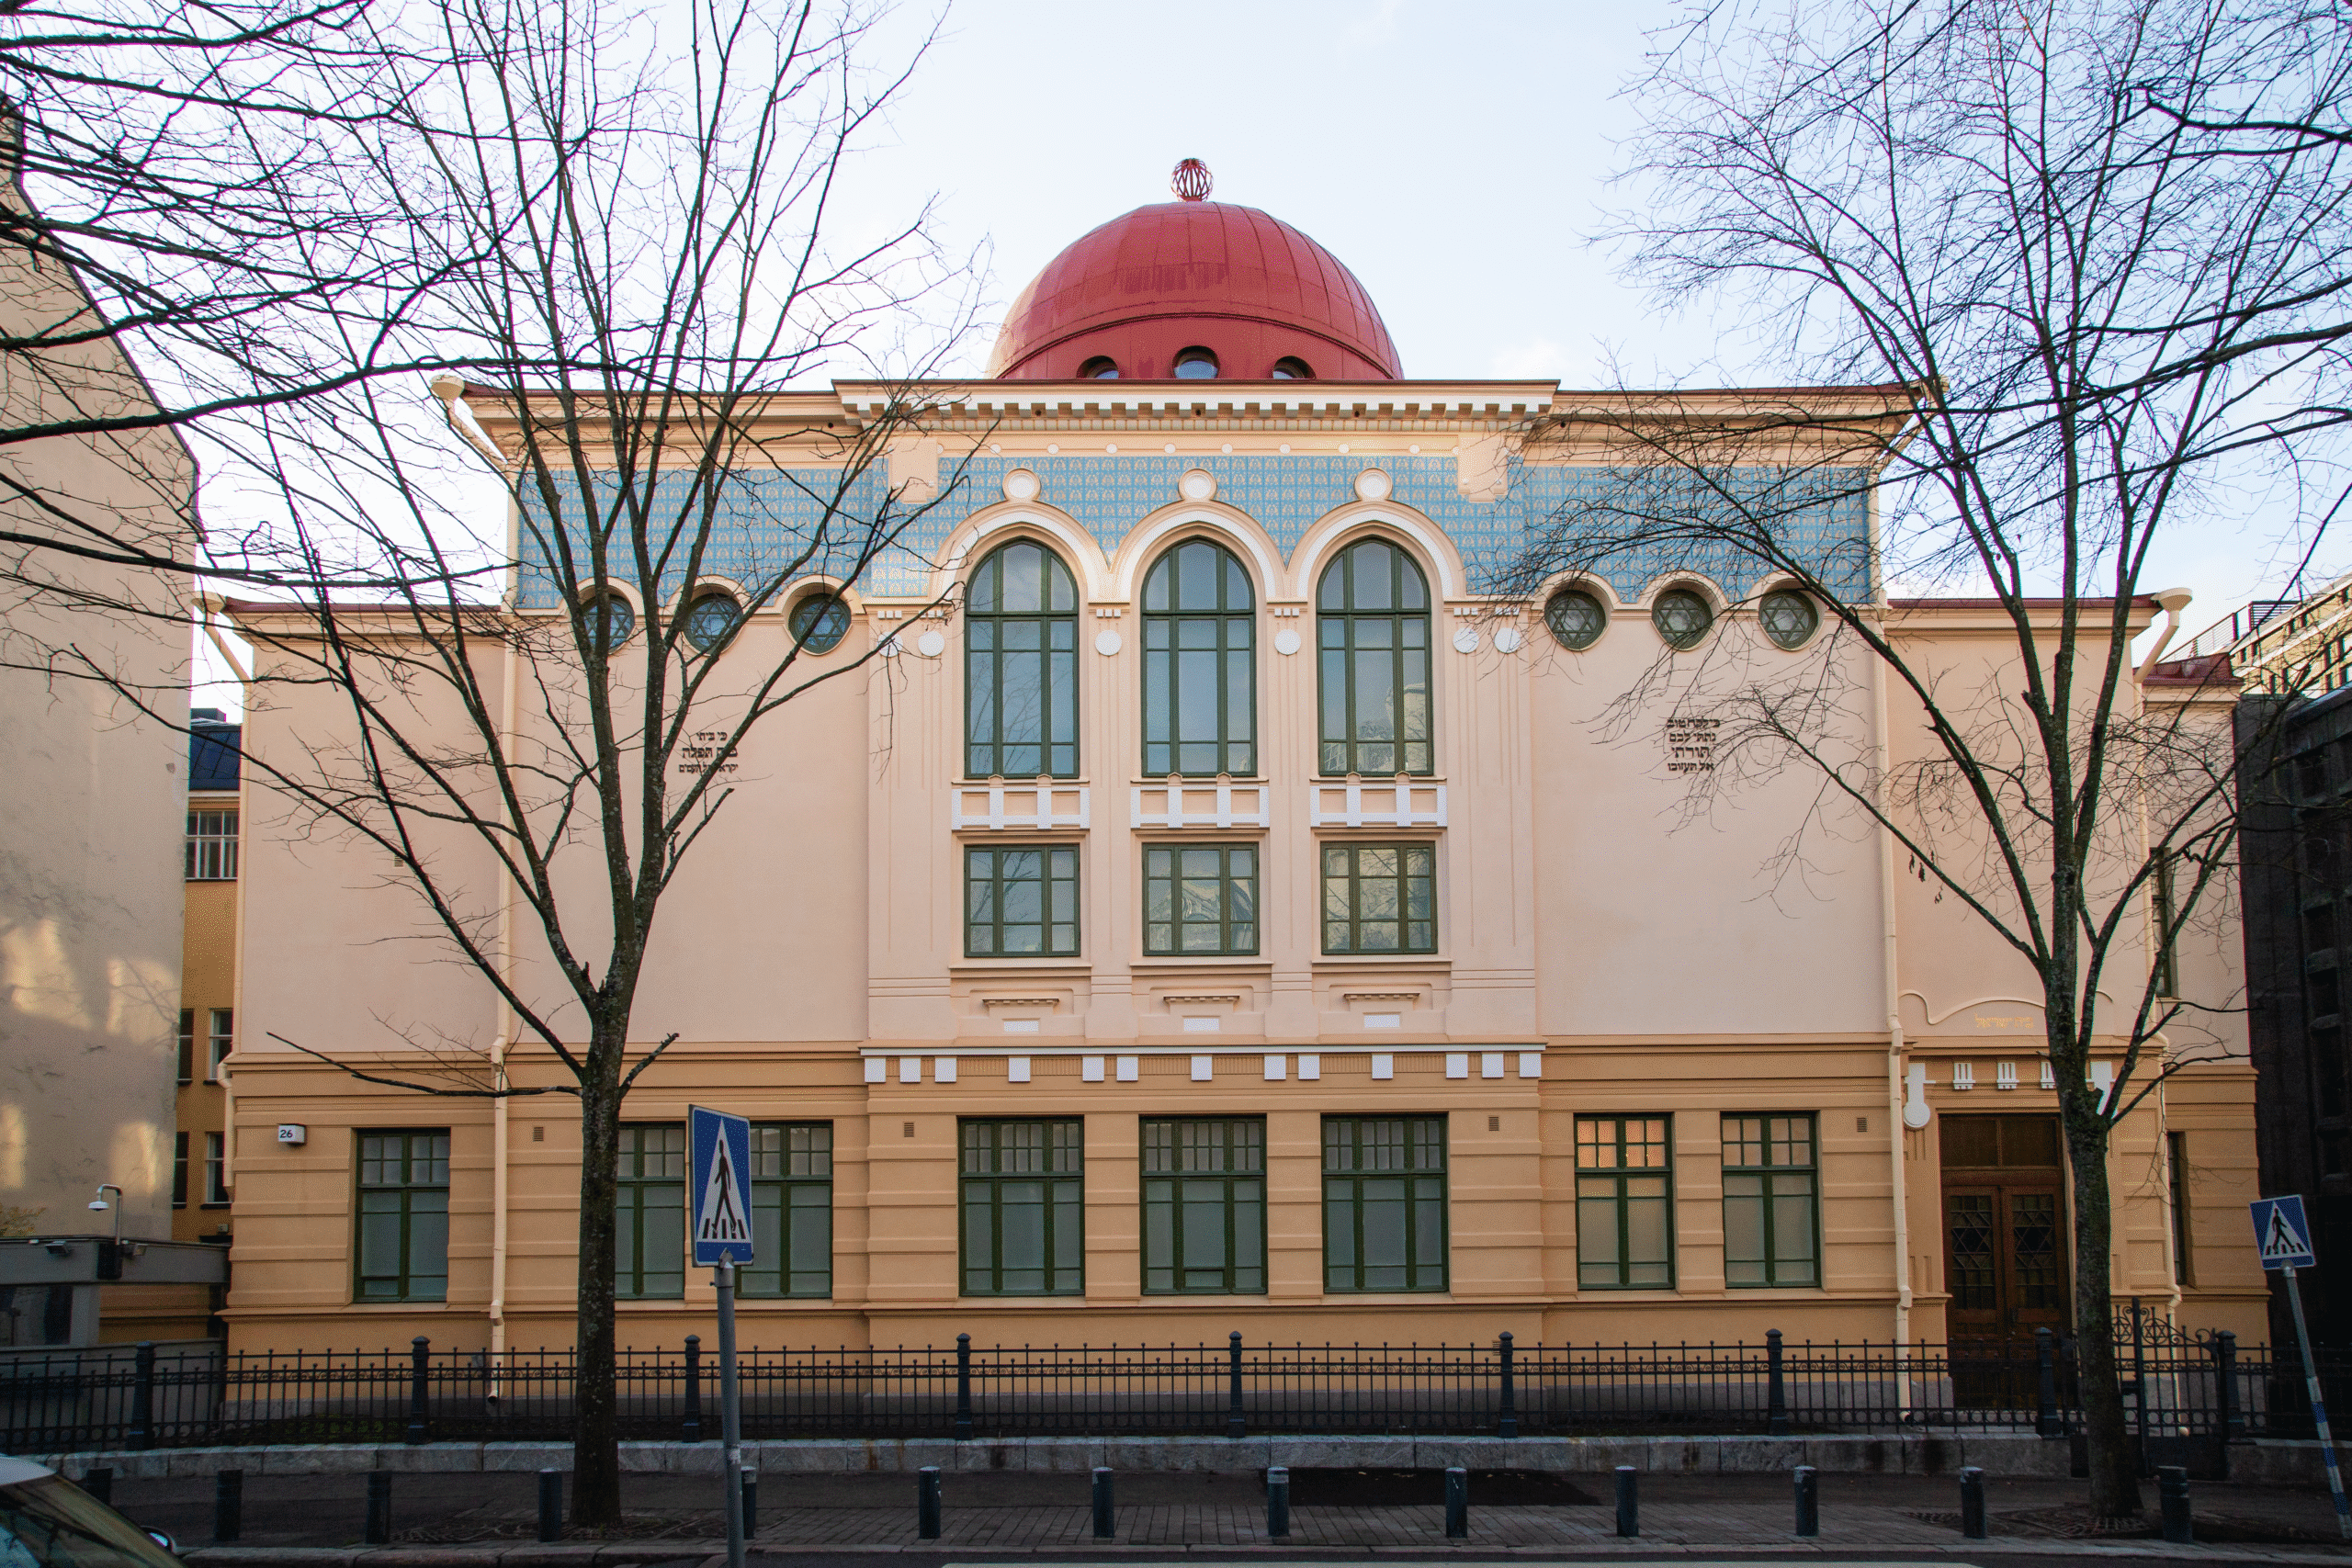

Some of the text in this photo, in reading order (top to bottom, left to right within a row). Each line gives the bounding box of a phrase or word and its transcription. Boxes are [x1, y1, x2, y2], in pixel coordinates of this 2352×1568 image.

[695, 731, 728, 741] כי ביתי
[1668, 729, 1716, 742] נתתי לכם
[682, 747, 738, 759] בת תפלה
[1670, 746, 1710, 759] תורתי
[1698, 759, 1715, 772] אל
[279, 1129, 293, 1139] 26
